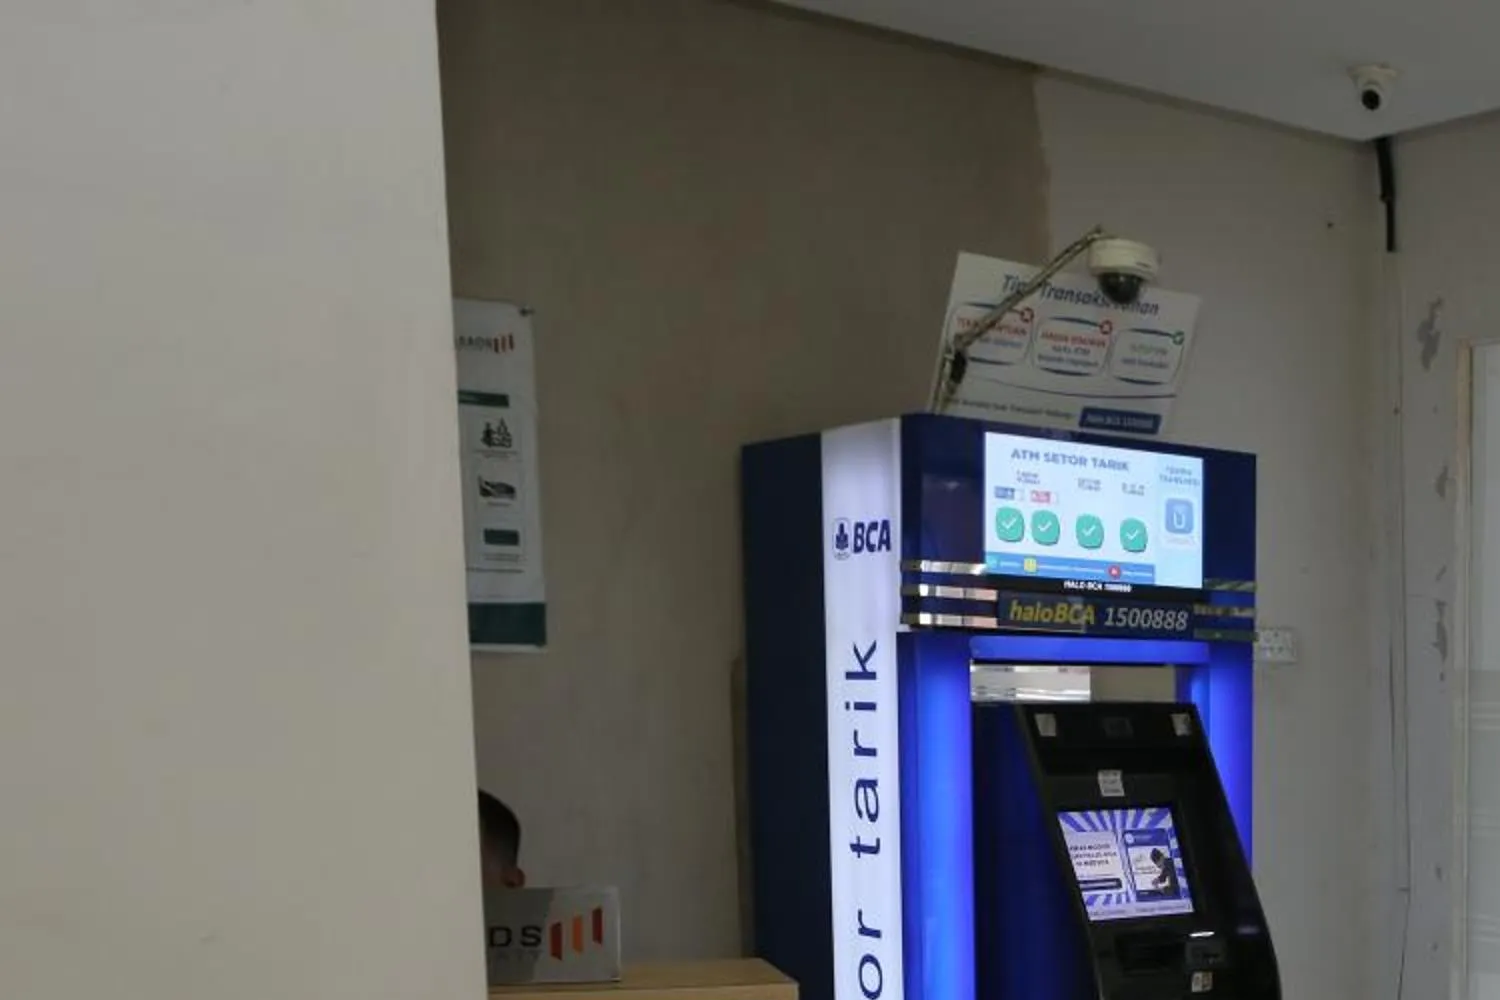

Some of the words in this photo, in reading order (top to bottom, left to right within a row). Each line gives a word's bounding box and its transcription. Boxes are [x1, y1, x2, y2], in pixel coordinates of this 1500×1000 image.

[1002, 272, 1040, 298] Tip
[1040, 276, 1113, 308] Transaks
[1010, 447, 1041, 463] ATM
[1043, 451, 1088, 468] SETOR
[1091, 456, 1130, 472] TARIK
[852, 519, 892, 553] BCA
[1009, 599, 1096, 626] haloBCA
[1104, 606, 1188, 631] 1500888
[845, 639, 882, 858] tarik
